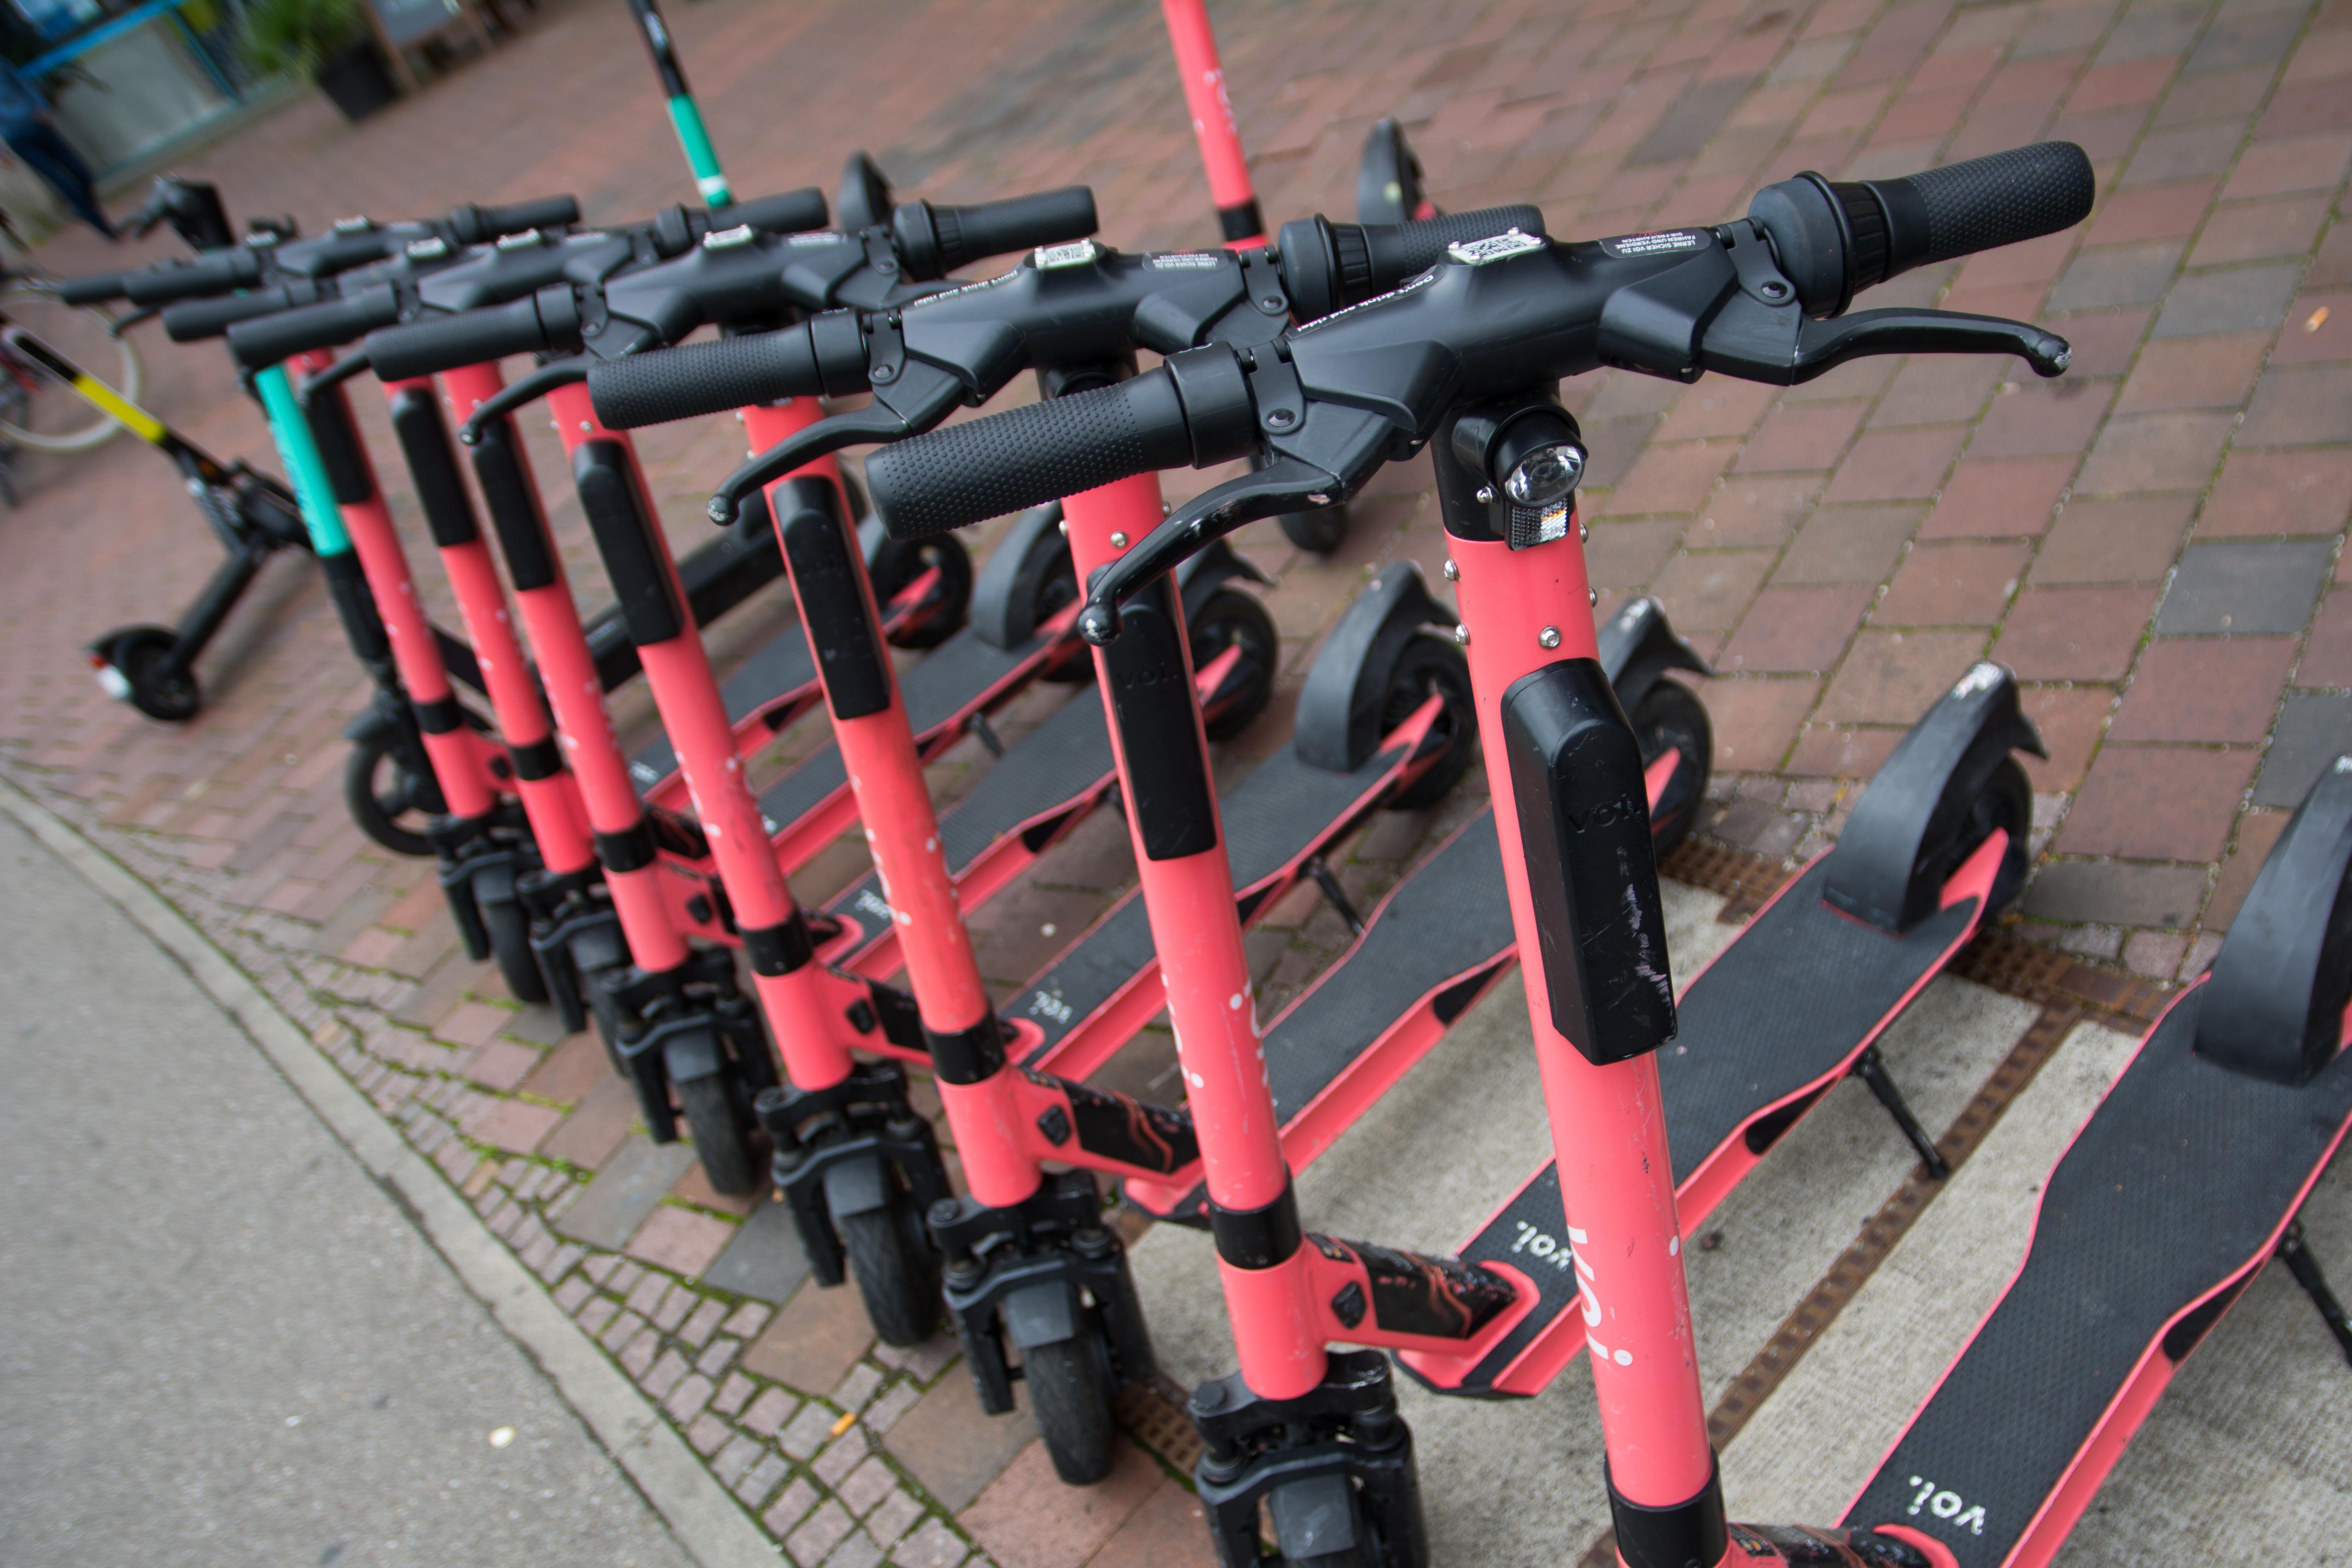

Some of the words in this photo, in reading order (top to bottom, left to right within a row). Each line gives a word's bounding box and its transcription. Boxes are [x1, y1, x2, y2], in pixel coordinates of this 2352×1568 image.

[1614, 240, 1651, 249] VERDIENE
[1667, 234, 1696, 243] FAHREN
[1396, 274, 1434, 294] Don't
[1358, 291, 1396, 307] drink
[1329, 305, 1356, 319] and
